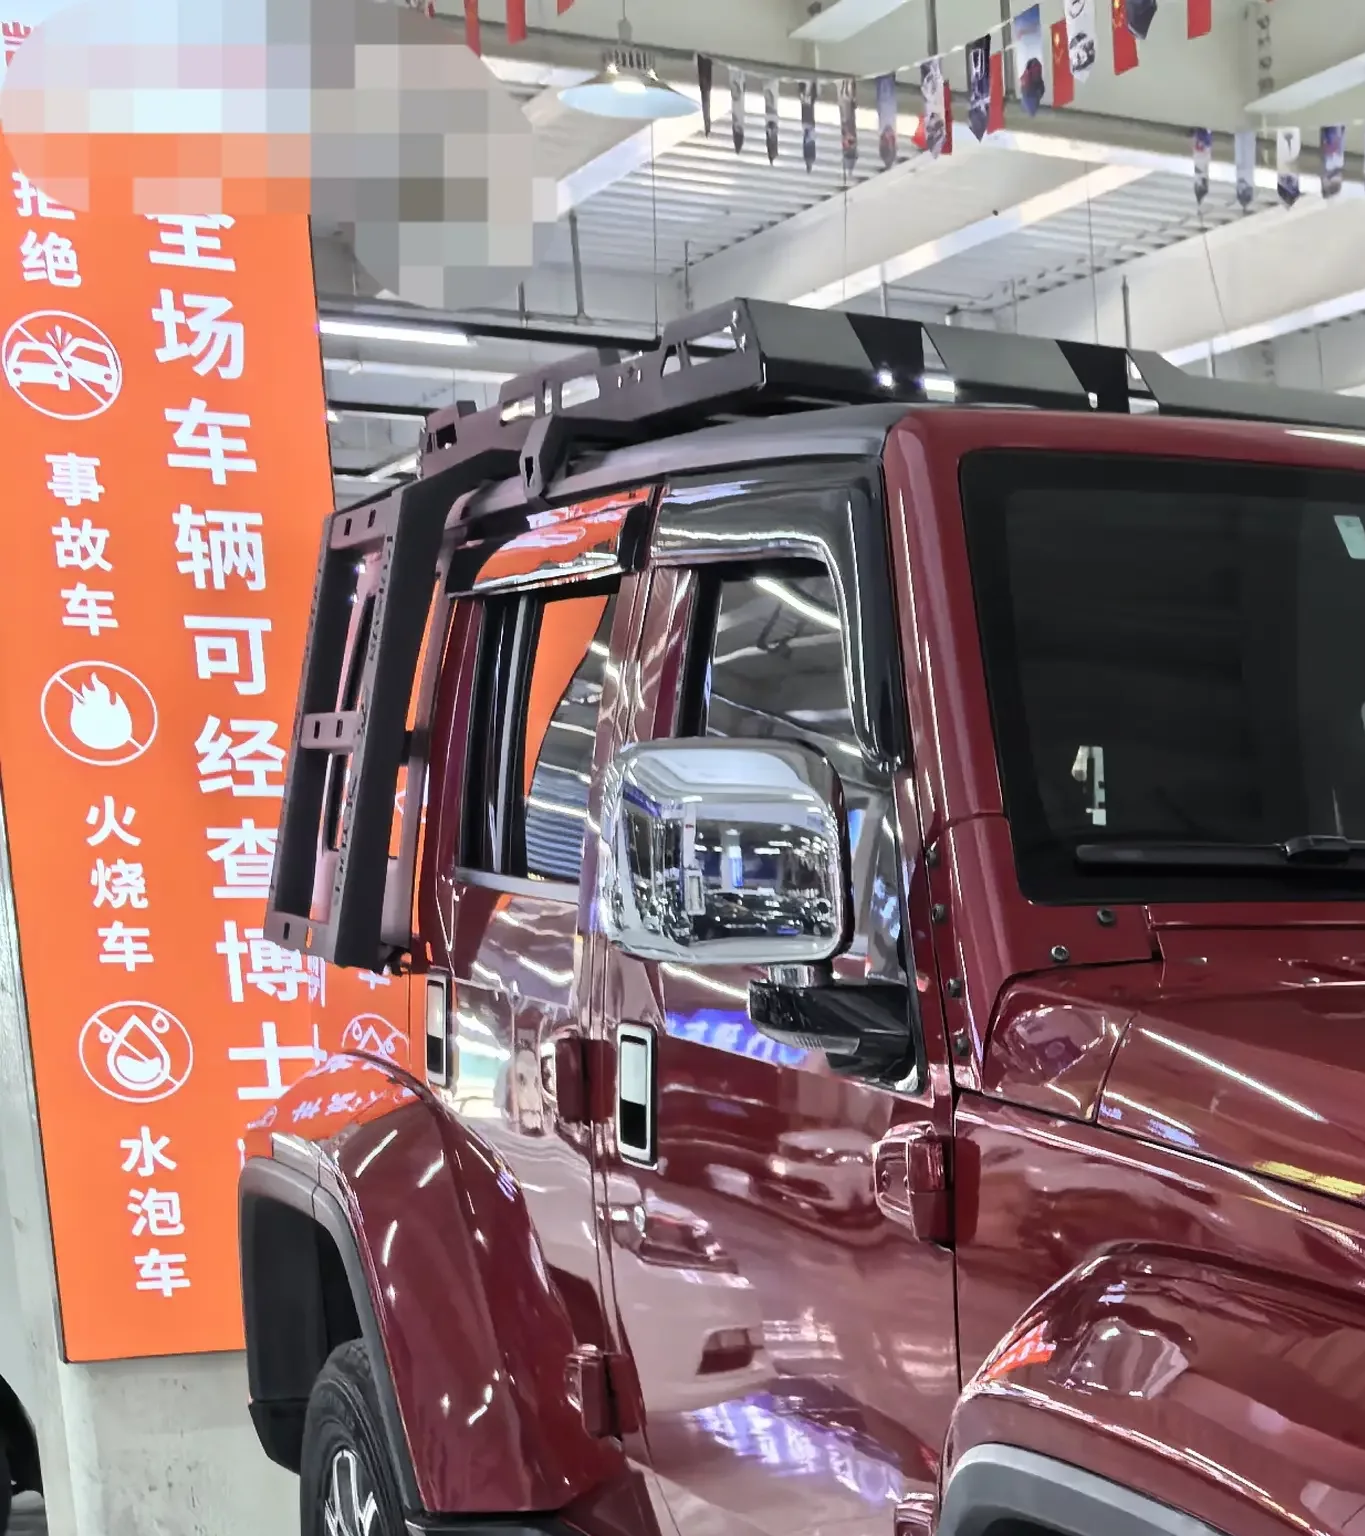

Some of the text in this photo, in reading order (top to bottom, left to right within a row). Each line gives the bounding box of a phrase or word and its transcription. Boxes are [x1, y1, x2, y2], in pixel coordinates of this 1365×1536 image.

[45, 451, 119, 636] 事故车
[85, 796, 154, 972] 火烧车
[120, 1125, 192, 1298] 水泡车
